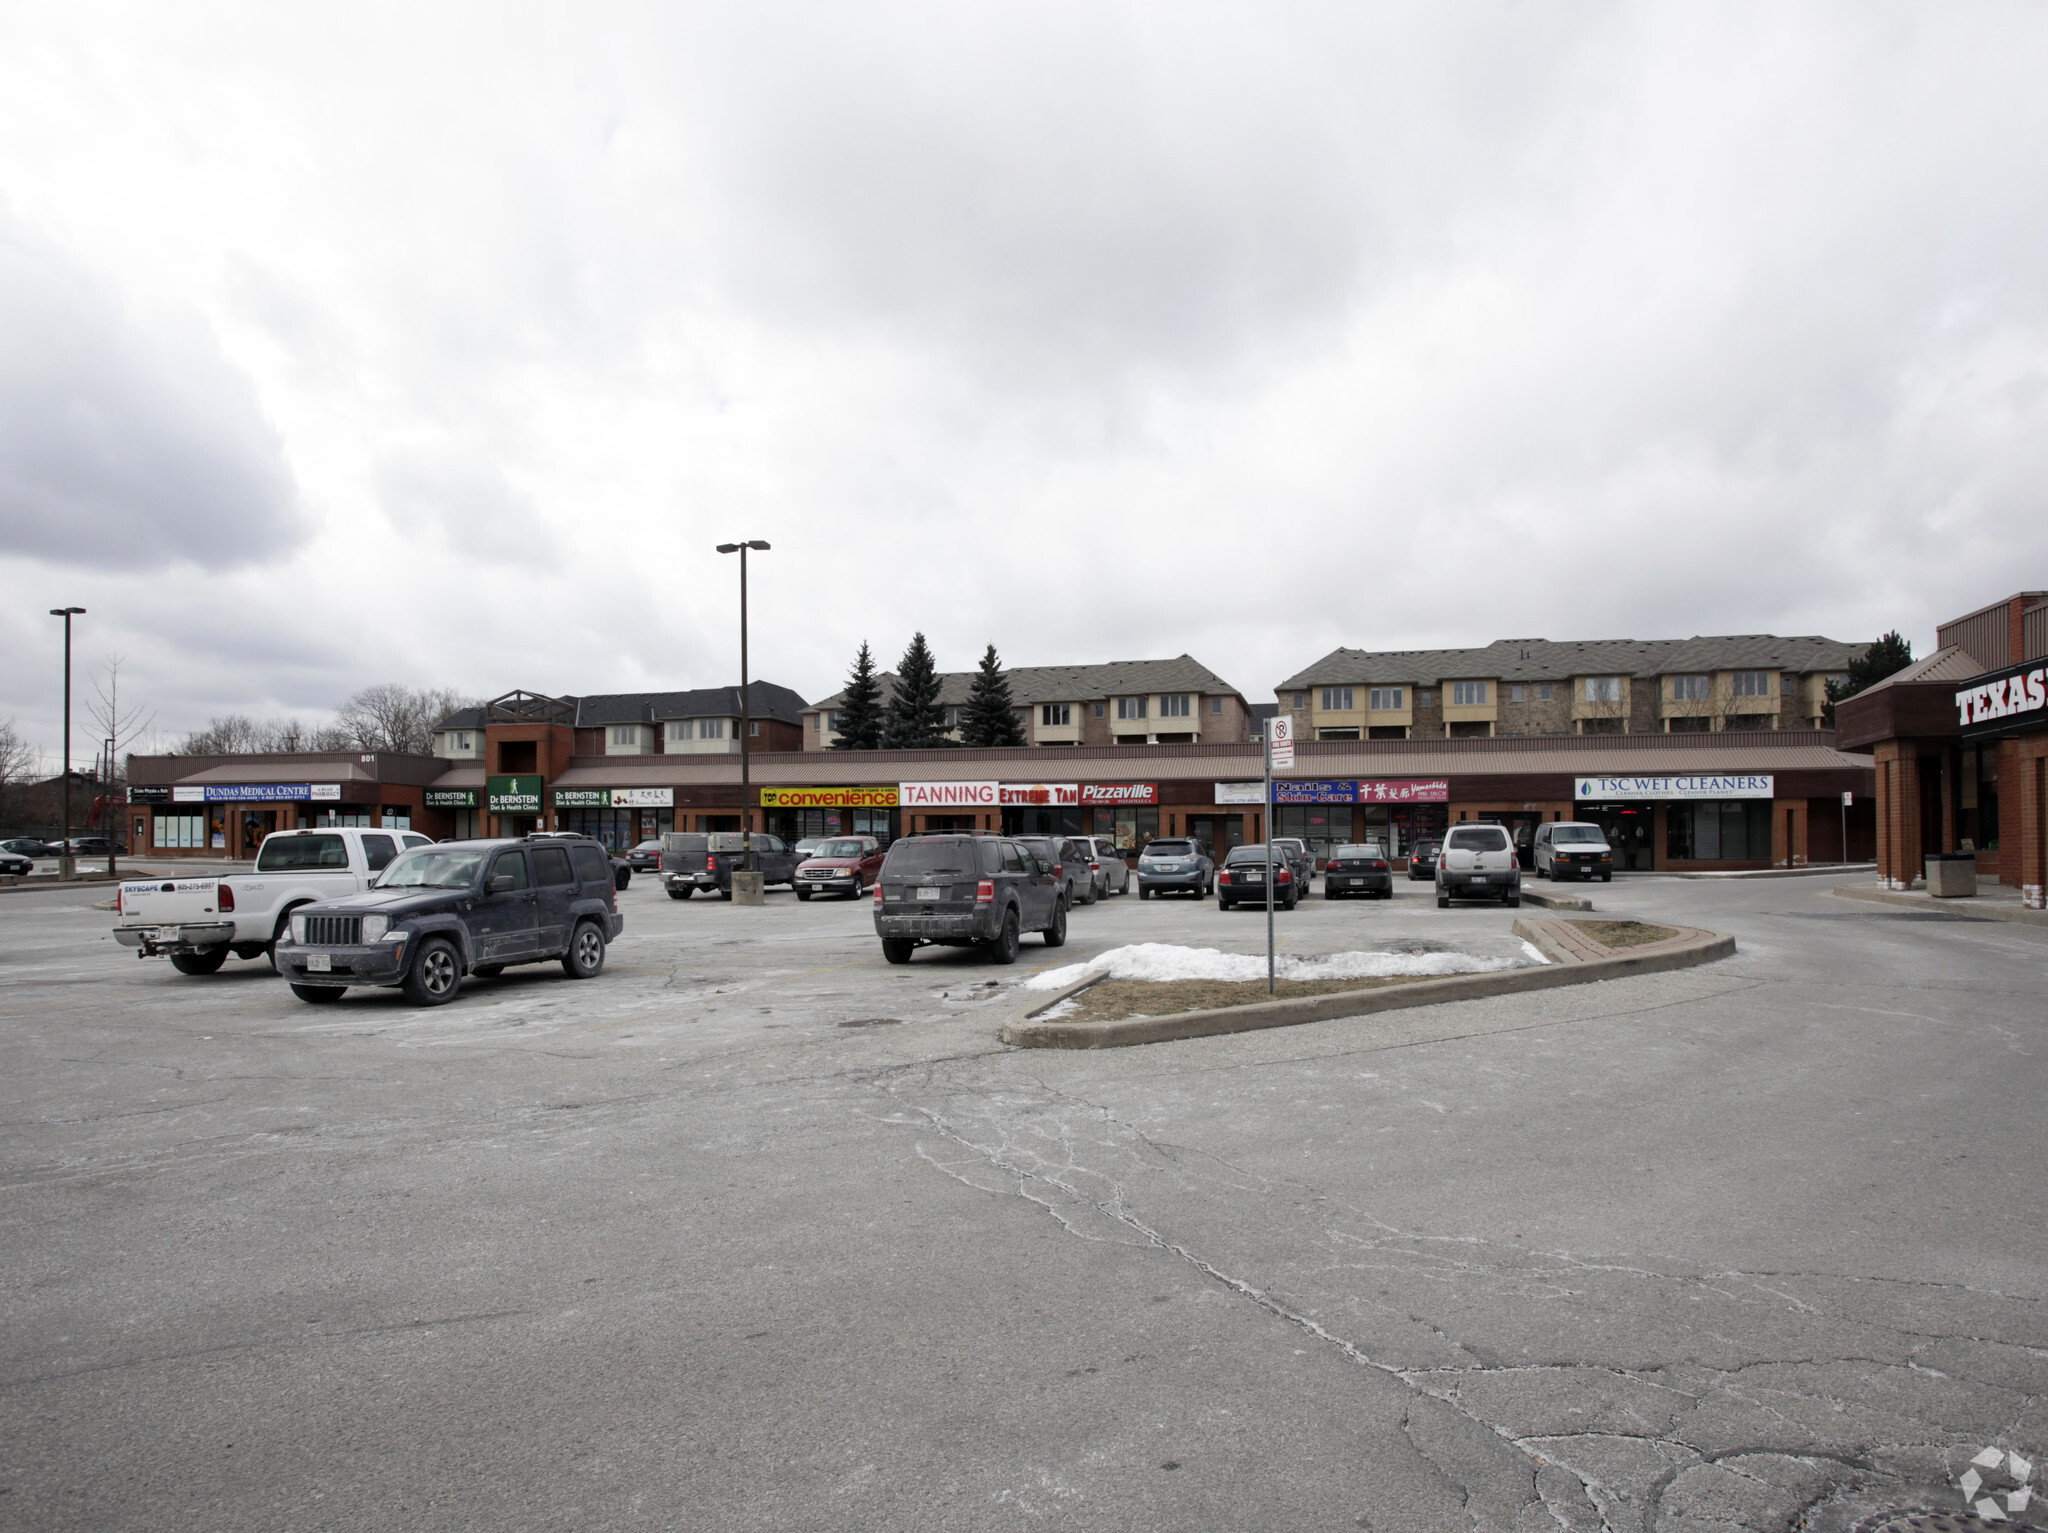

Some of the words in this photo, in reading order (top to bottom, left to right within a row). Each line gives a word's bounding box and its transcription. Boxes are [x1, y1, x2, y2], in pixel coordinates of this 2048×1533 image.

[1956, 668, 2045, 726] TEXAS
[1276, 782, 1332, 791] Nails
[1338, 783, 1352, 791] &
[1598, 778, 1630, 791] TSC
[1634, 778, 1672, 791] WET
[1676, 776, 1768, 790] CLEANERS
[206, 786, 239, 797] DUNDAS
[239, 786, 275, 796] MEDICAL
[276, 785, 309, 795] CENTRE
[434, 792, 467, 800] BERNSTEIN
[565, 791, 600, 800] BERNSTEIN
[905, 785, 994, 803] TANNING
[1000, 788, 1050, 804] EXTREME
[1055, 788, 1077, 803] TAN
[1082, 784, 1153, 799] Pizzaville
[500, 795, 538, 804] BERNSTEIN
[764, 793, 776, 803] TOP
[779, 790, 897, 805] convenience
[1277, 792, 1353, 803] Skin-Care
[124, 884, 159, 893] SKYSCAPE
